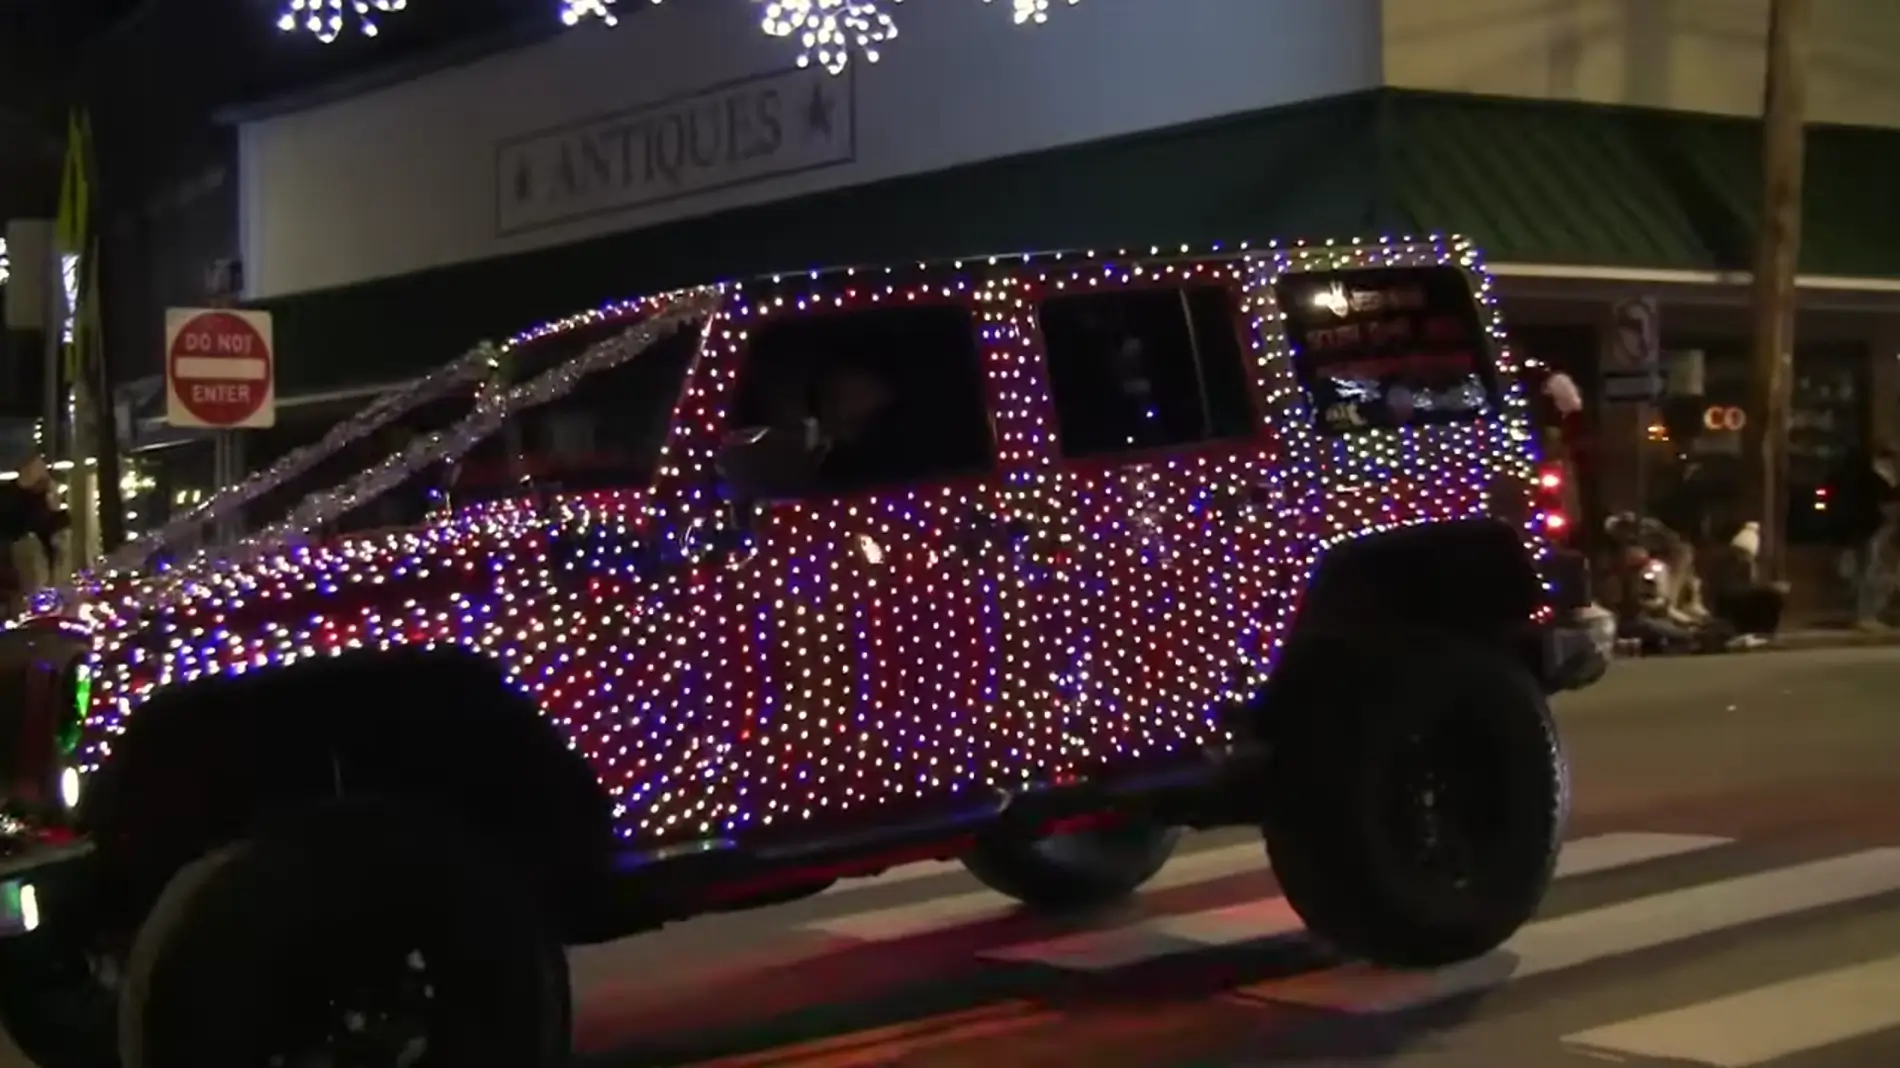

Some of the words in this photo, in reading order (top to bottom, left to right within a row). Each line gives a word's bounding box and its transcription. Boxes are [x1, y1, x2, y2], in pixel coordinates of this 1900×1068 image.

[549, 90, 783, 200] ANTIQUES
[185, 333, 211, 351] DO
[218, 333, 253, 354] NOT
[192, 384, 250, 403] ENTER
